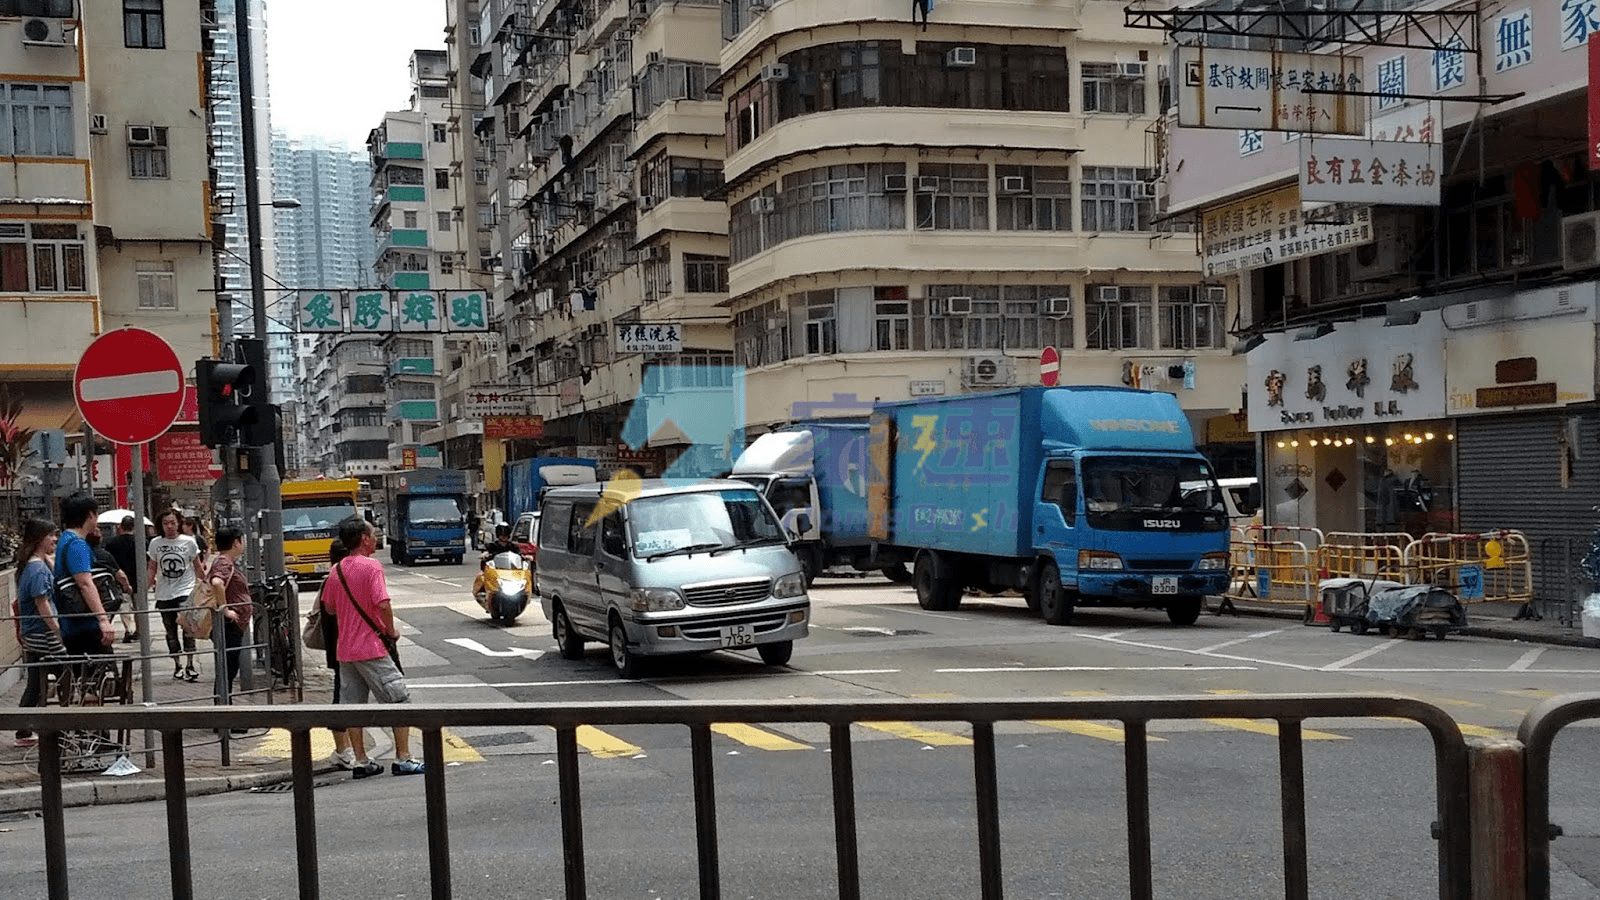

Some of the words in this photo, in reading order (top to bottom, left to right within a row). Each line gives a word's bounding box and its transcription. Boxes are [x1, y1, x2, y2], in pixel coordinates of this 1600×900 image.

[1307, 154, 1436, 187] 良有五金漆油
[1143, 519, 1181, 528] ISUZU
[1159, 577, 1171, 586] JR
[1154, 585, 1176, 593] 9308
[730, 625, 745, 637] LP
[725, 634, 752, 646] 7132
